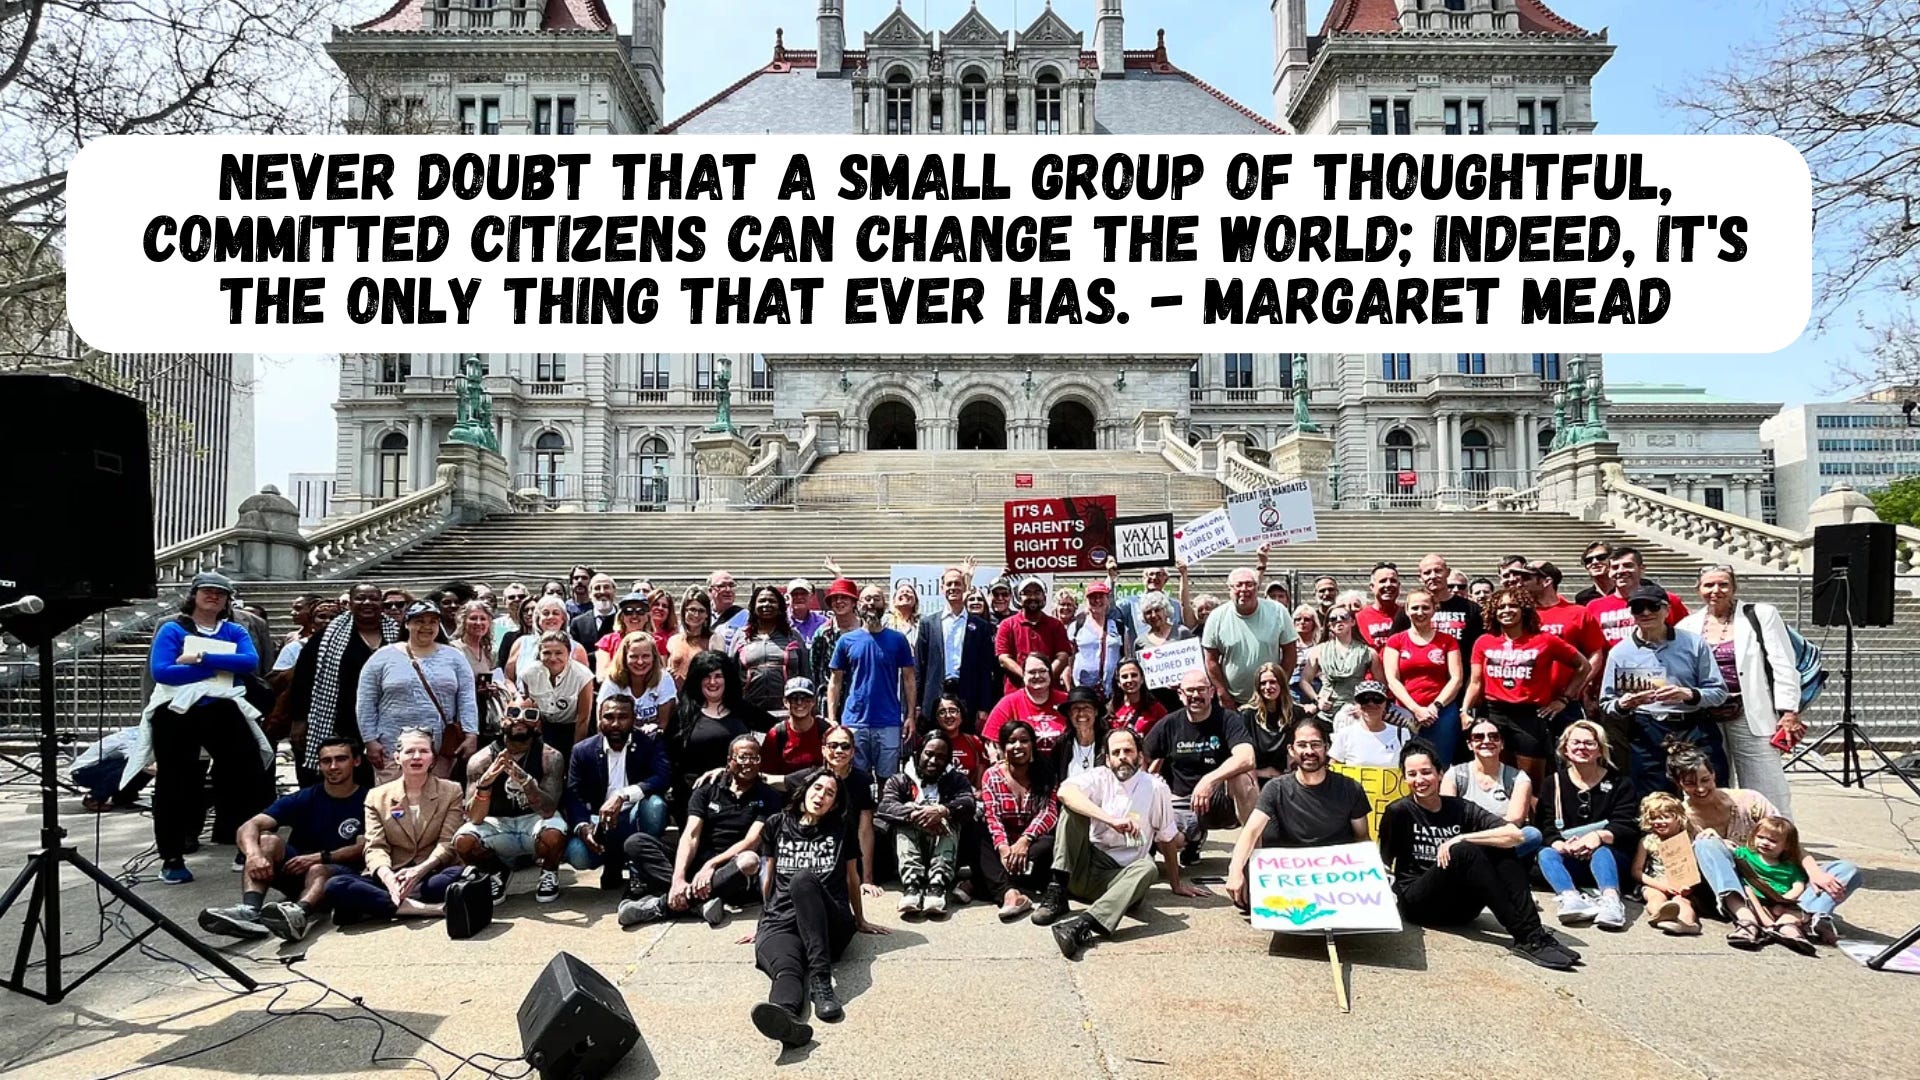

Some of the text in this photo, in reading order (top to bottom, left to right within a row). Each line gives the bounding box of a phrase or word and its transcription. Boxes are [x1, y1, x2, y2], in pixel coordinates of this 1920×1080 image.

[1272, 481, 1308, 496] MANDATES
[1012, 504, 1054, 518] IT'S A
[1013, 519, 1086, 535] PARENT'S
[1014, 537, 1084, 552] RIGHT TO
[1178, 525, 1226, 553] INJURED BY
[1186, 536, 1231, 564] A VACCINE
[1015, 555, 1078, 570] CHOOSE
[1154, 645, 1198, 659] Someone
[1144, 657, 1196, 674] INJURED BY
[1487, 664, 1533, 679] CHOICE
[1150, 673, 1182, 687] A VACC
[1257, 853, 1365, 871] MEDICAL
[1259, 867, 1384, 889] FREEDOM
[1314, 891, 1382, 906] NOW
